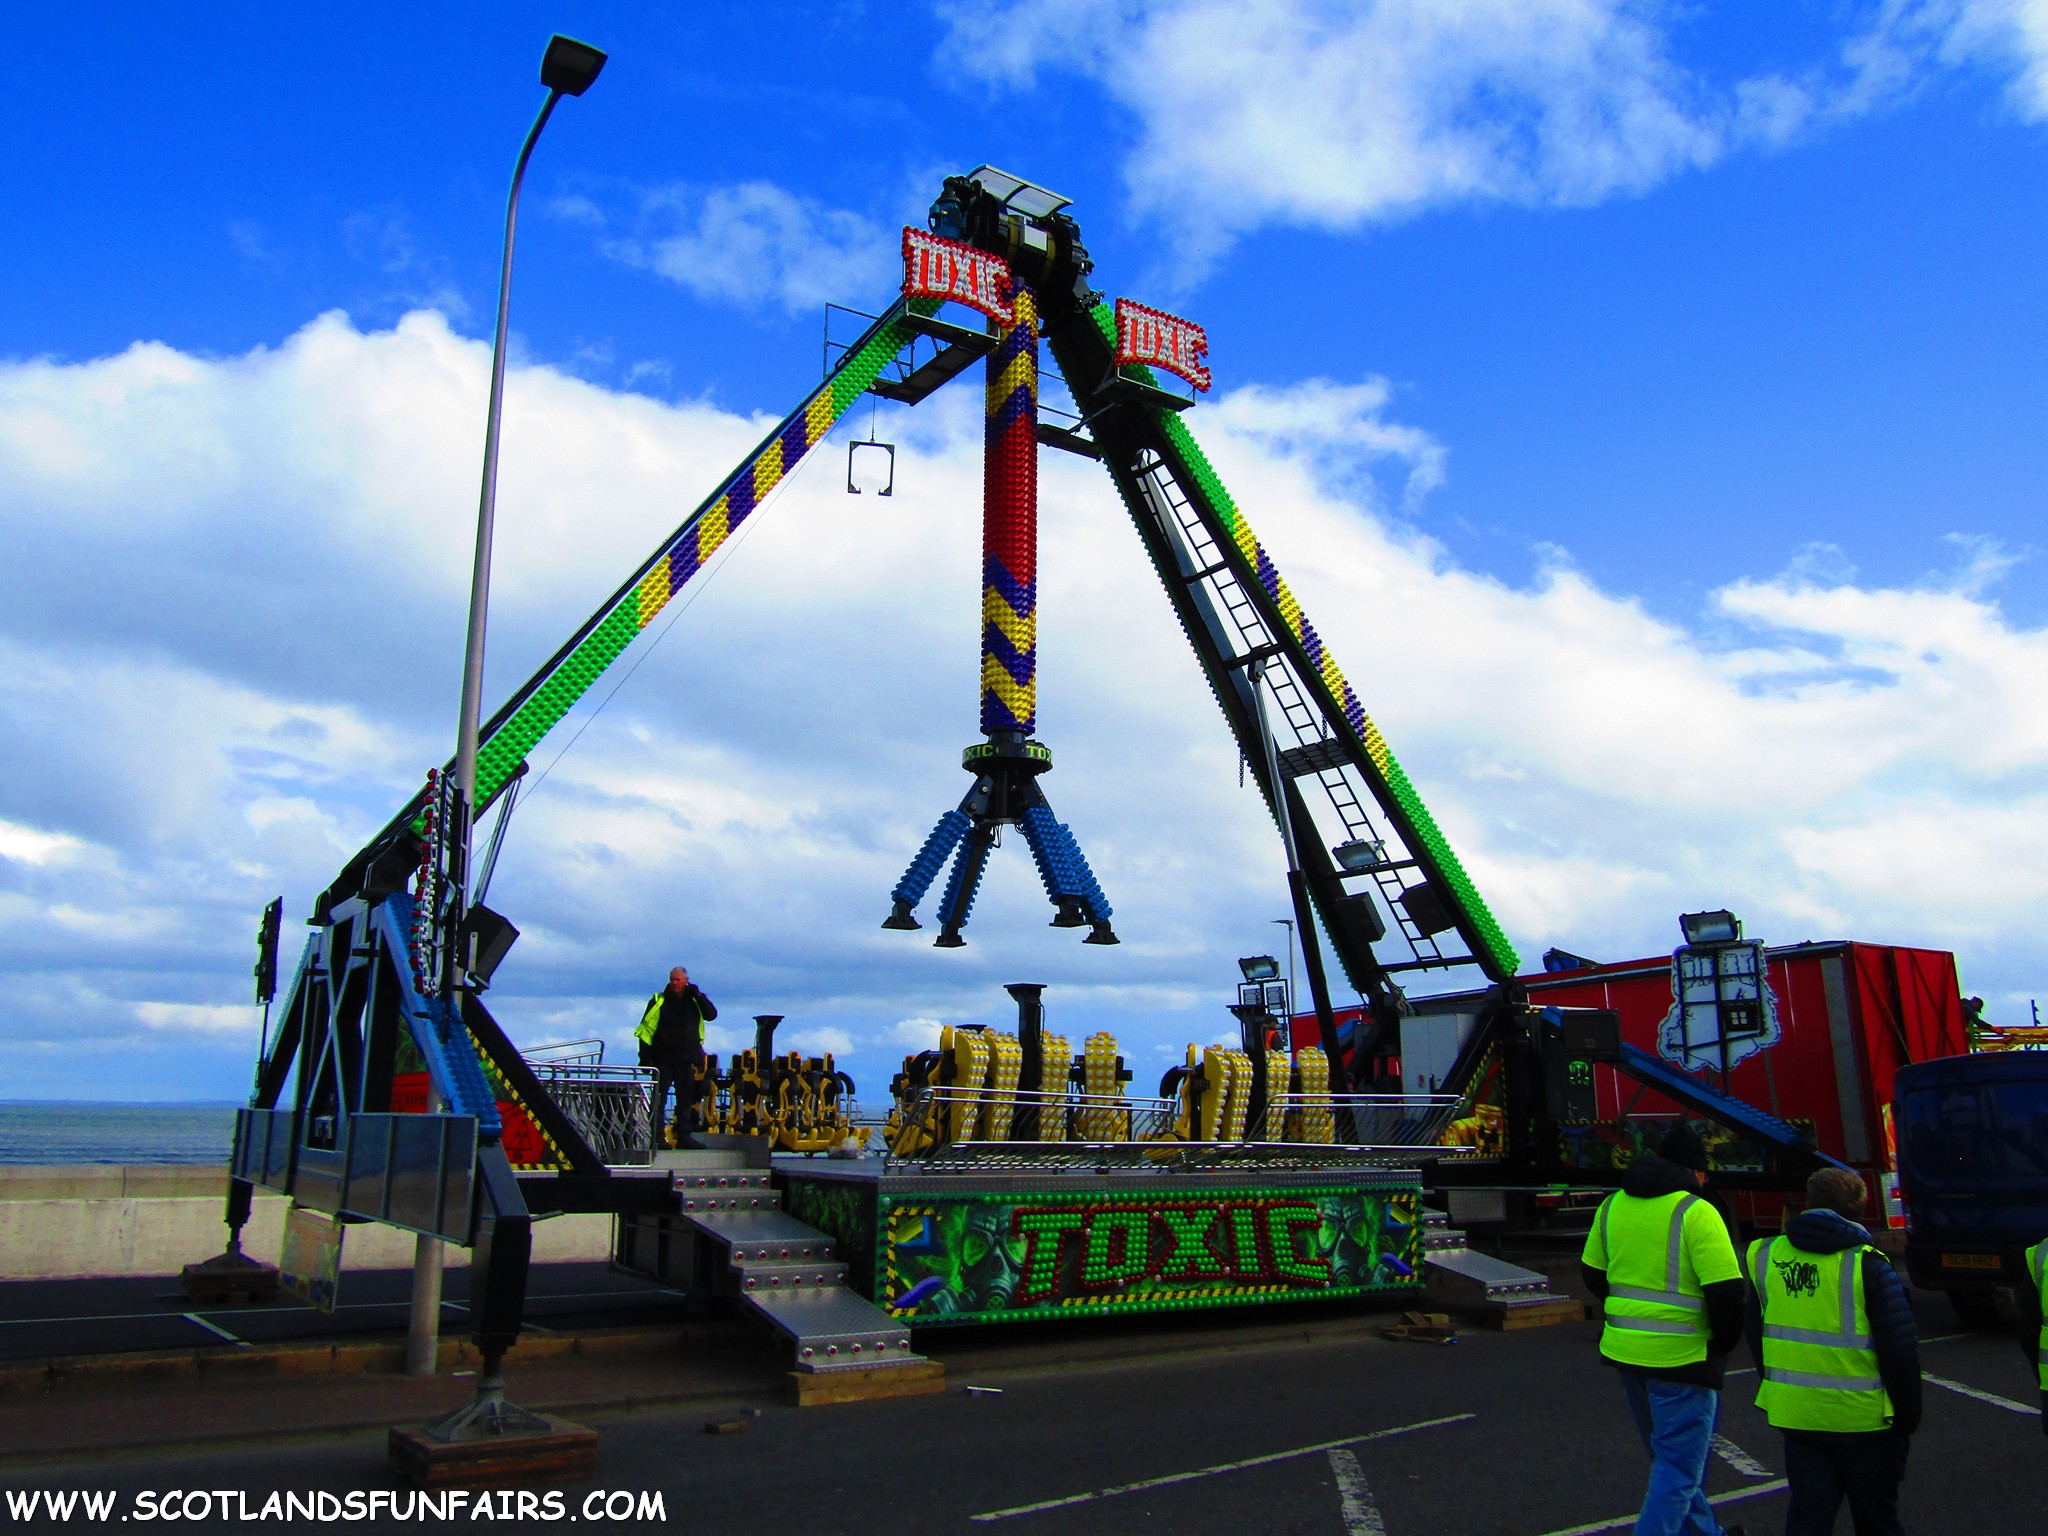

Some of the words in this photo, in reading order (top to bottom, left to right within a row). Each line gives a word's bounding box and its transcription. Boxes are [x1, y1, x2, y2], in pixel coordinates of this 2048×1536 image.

[908, 234, 1013, 321] TOXIC
[1119, 303, 1210, 389] TOXIC
[1014, 1202, 1332, 1300] TOXIC
